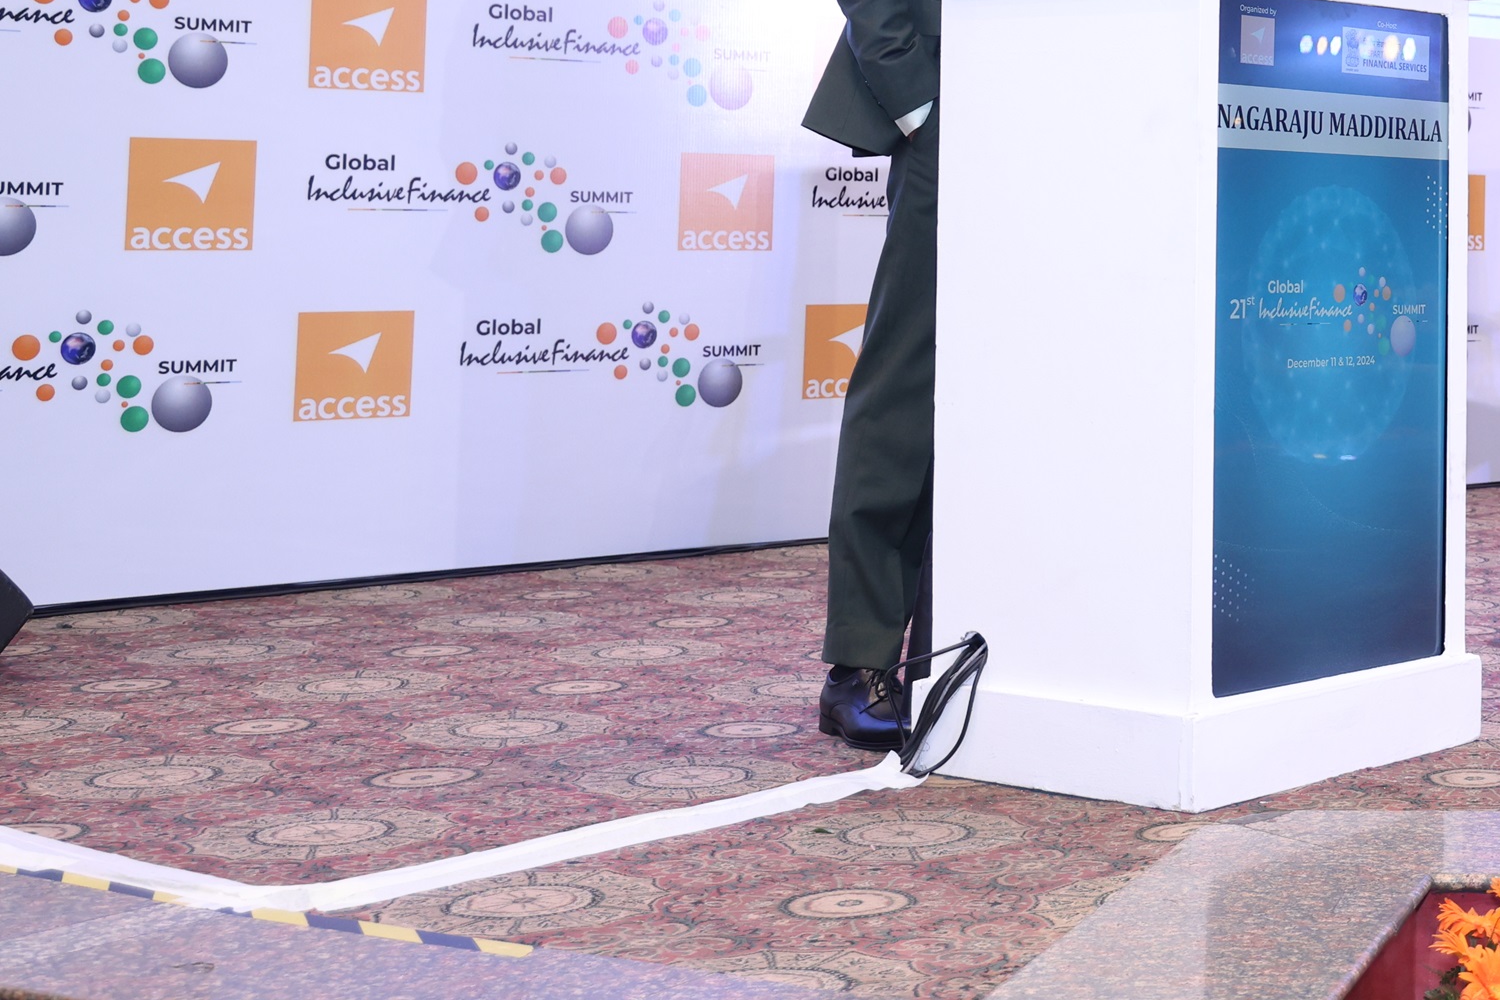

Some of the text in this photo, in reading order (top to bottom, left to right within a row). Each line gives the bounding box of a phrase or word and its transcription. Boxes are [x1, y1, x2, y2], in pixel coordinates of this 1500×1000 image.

[488, 3, 553, 23] Global
[1240, 4, 1277, 16] Organized by
[174, 16, 252, 34] SUMMIT
[1377, 21, 1398, 30] Co-Host
[713, 47, 771, 63] SUMMIT
[1241, 53, 1273, 65] access
[1362, 59, 1427, 73] FINANCIAL SERVICES
[313, 65, 420, 92] access
[1218, 103, 1443, 142] NAGARAJU MADDIRALA
[325, 154, 395, 171] Global
[825, 166, 879, 182] Global
[570, 190, 633, 204] SUMMIT
[812, 185, 886, 209] Inclusive
[130, 225, 248, 250] access
[681, 228, 769, 250] access
[1268, 280, 1304, 294] Global
[1392, 304, 1425, 315] SUMMIT
[476, 318, 541, 336] Global
[703, 344, 761, 358] SUMMIT
[158, 358, 237, 375] SUMMIT
[1287, 357, 1329, 369] December
[1331, 357, 1337, 366] 11
[1338, 357, 1344, 366] &
[1357, 355, 1375, 366] 2024
[806, 375, 849, 398] acc
[298, 393, 407, 421] access
